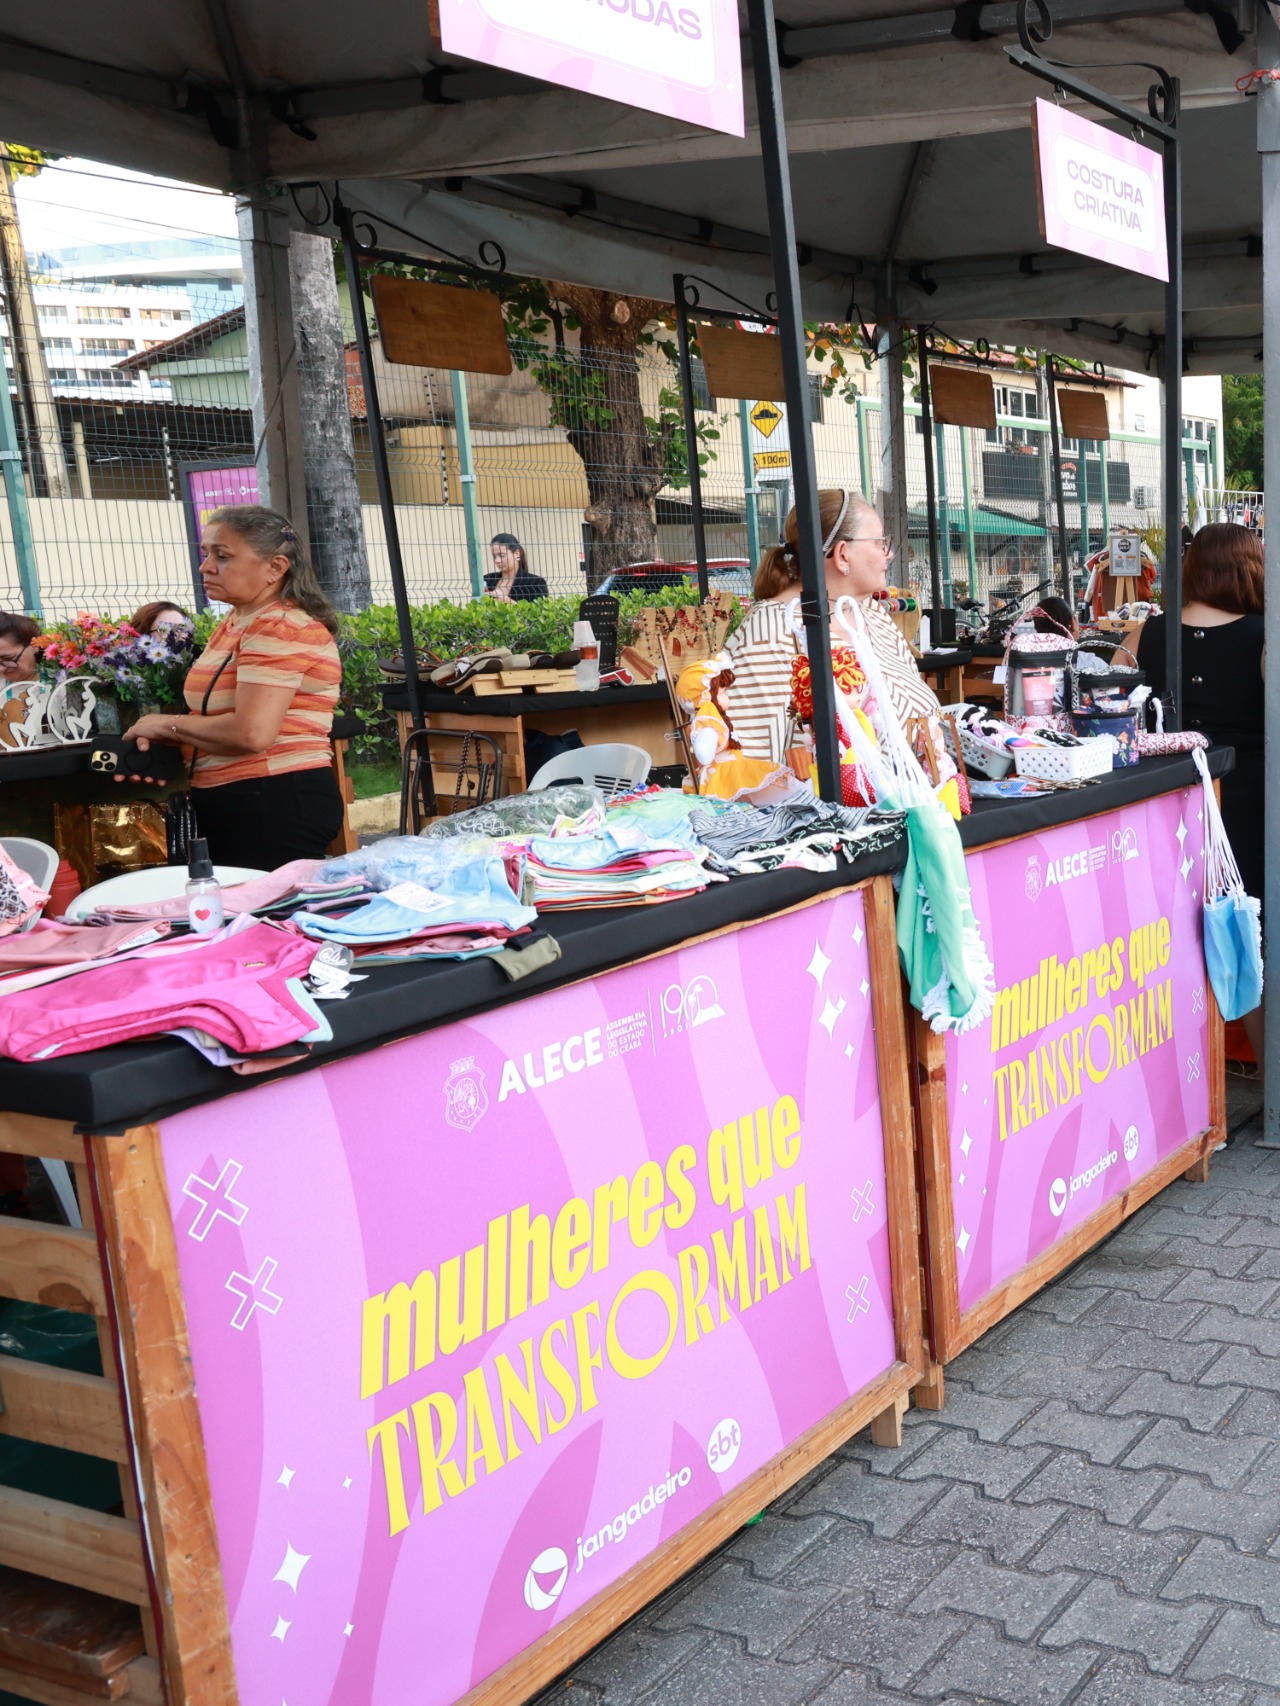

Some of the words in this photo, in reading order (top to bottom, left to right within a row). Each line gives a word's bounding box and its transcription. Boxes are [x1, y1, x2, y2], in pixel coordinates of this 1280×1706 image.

[1067, 159, 1145, 208] COSTURA
[1073, 190, 1142, 233] CRIATIVA
[761, 455, 788, 465] 100m
[1045, 850, 1089, 888] ALECE
[990, 936, 1125, 1054] mulheres
[1129, 916, 1171, 989] que
[605, 1010, 646, 1033] ASSEMBLEIA
[606, 1018, 648, 1041] LEGISLATIVA
[607, 1039, 618, 1050] DO
[619, 1029, 645, 1045] ESTADO
[498, 1026, 605, 1103] ALECE
[608, 1048, 619, 1058] DO
[992, 978, 1173, 1143] TRANSFORMAM
[1124, 1131, 1138, 1154] sbt
[1069, 1149, 1118, 1200] jangadeiro
[360, 1144, 698, 1401] mulheres
[707, 1095, 801, 1215] que
[366, 1182, 812, 1537] TRANSFORMAM
[710, 1423, 740, 1465] sbt
[575, 1466, 692, 1574] jangadeiro
